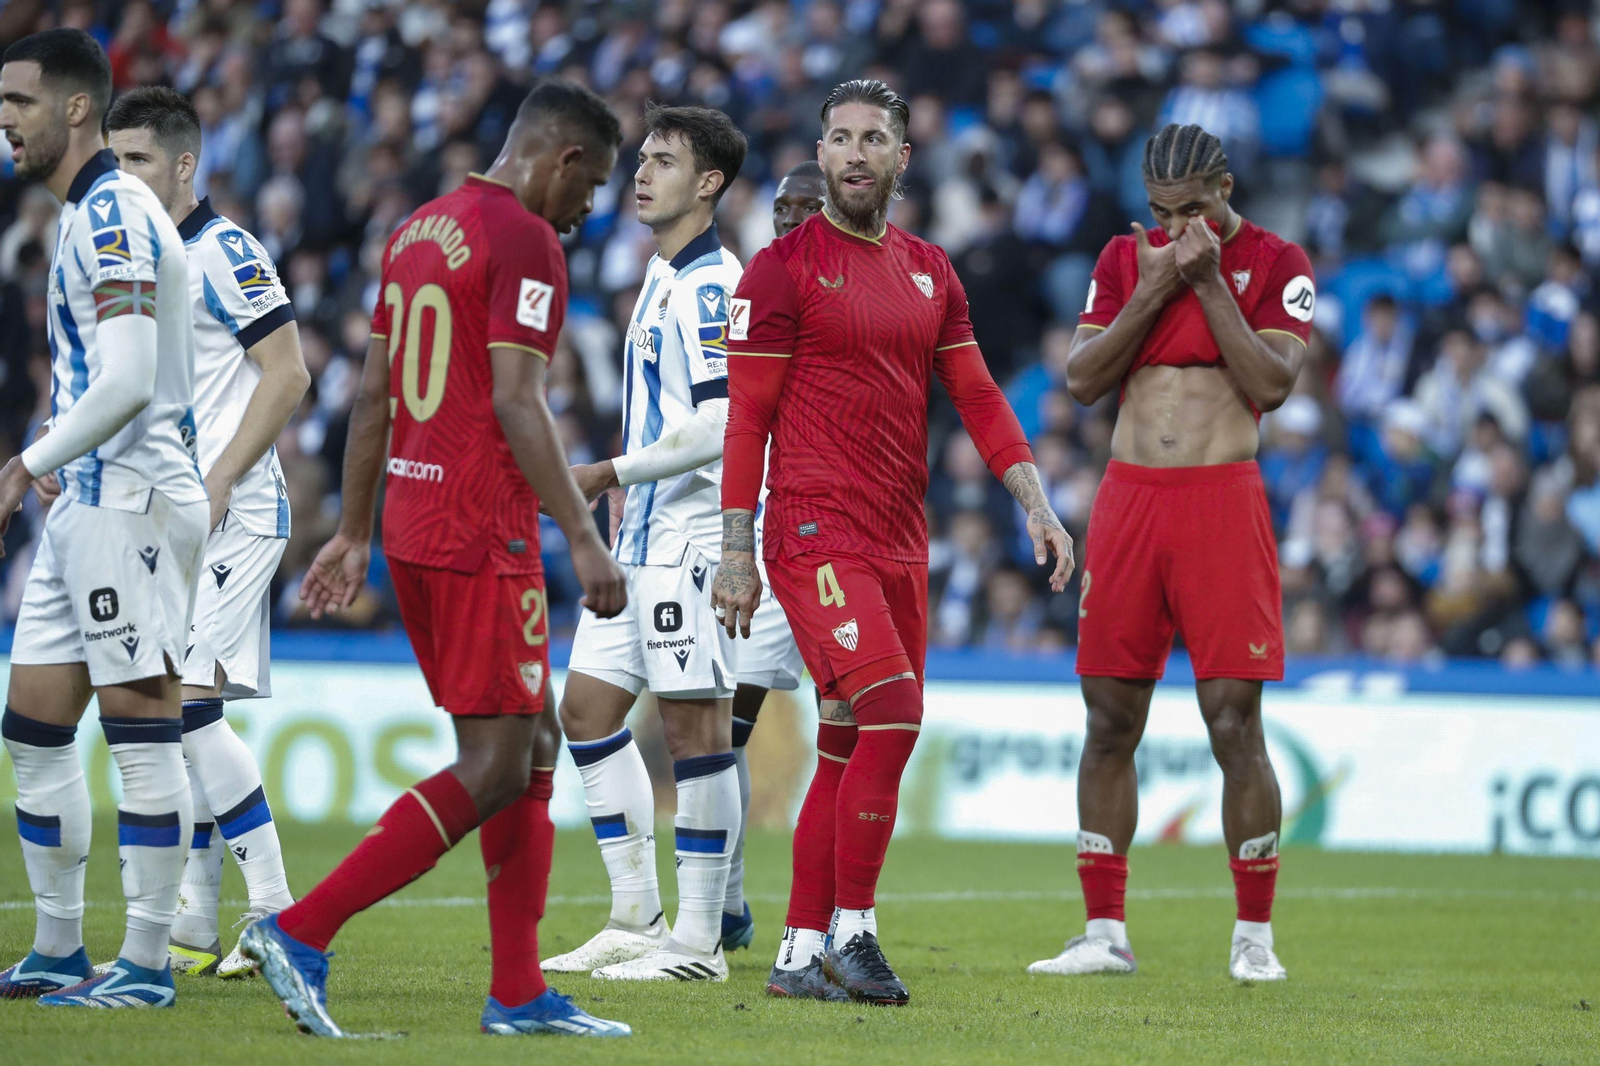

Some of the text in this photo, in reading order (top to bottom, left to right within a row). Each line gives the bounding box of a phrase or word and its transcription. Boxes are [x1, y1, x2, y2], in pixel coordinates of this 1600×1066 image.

[389, 214, 471, 271] FERNANDO
[100, 267, 133, 279] REALE
[251, 290, 279, 309] REALE
[384, 282, 453, 423] 20
[706, 361, 728, 370] REAL
[816, 563, 847, 609] 4
[84, 622, 138, 642] finetwork
[646, 635, 696, 650] finetwork
[858, 812, 890, 822] SFC
